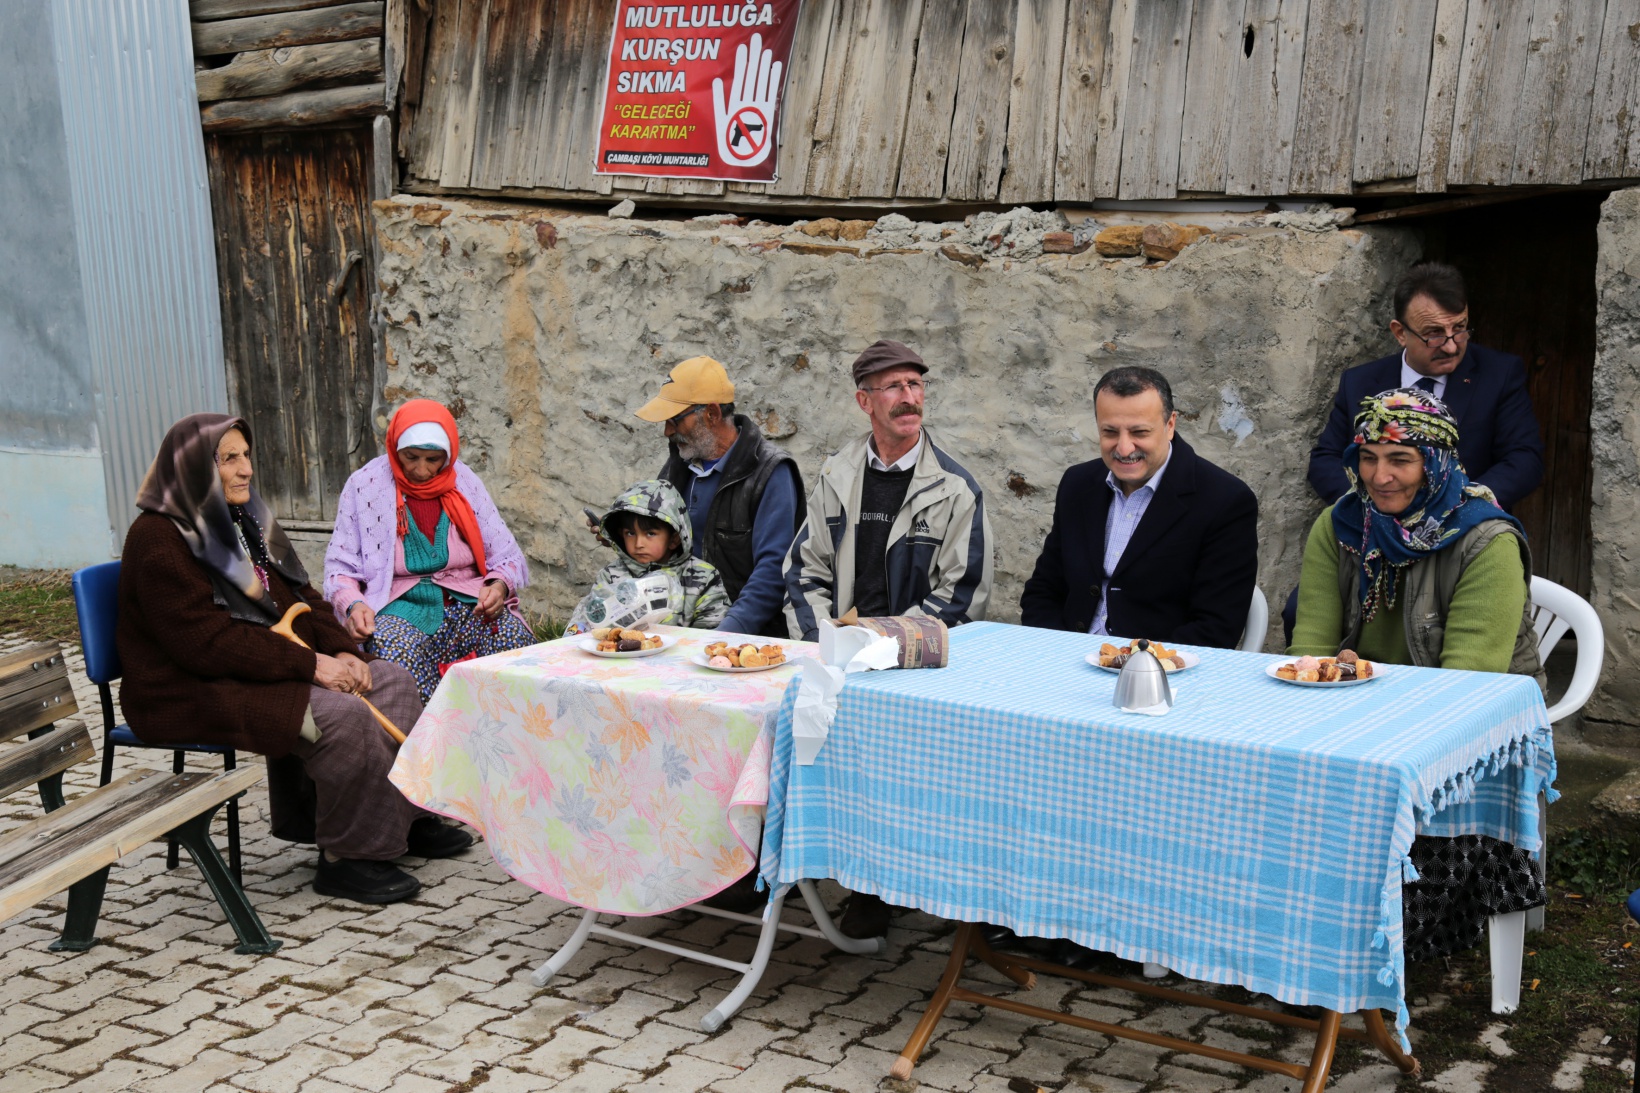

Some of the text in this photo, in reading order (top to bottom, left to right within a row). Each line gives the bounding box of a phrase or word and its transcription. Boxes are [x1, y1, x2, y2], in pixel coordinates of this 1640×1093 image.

[625, 0, 773, 28] MUTLULUĞA
[621, 38, 722, 65] KURŞUN
[616, 71, 686, 94] SIKMA
[607, 153, 709, 166] ÇAMBAŞI KÖYÜ MUHTARLIĞI
